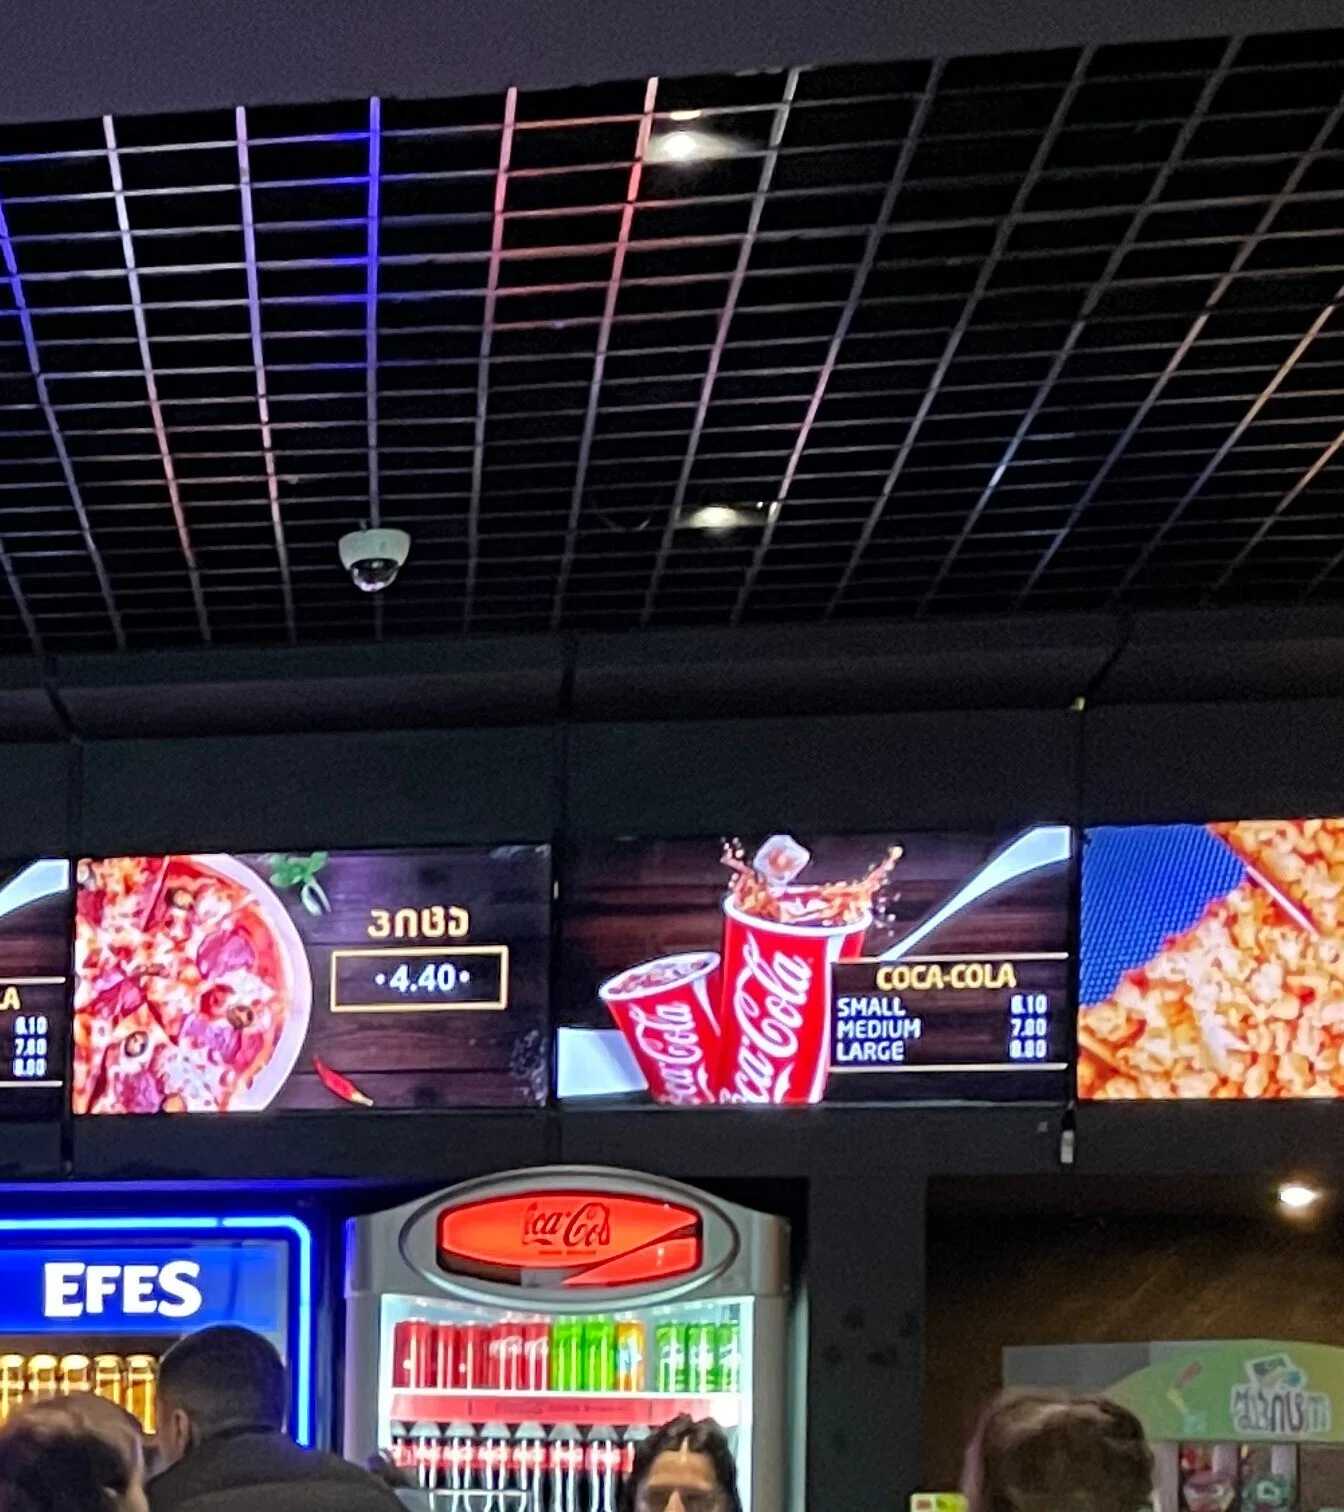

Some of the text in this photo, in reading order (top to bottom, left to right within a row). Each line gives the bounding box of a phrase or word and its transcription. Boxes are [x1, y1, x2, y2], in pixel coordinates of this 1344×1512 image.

[389, 963, 456, 992] 4.40
[876, 963, 1016, 990] COCA-COLA
[837, 997, 906, 1017] SMALL
[837, 1018, 922, 1039] MEDIUM
[836, 1041, 904, 1061] LARGE
[44, 1260, 202, 1317] EFES
